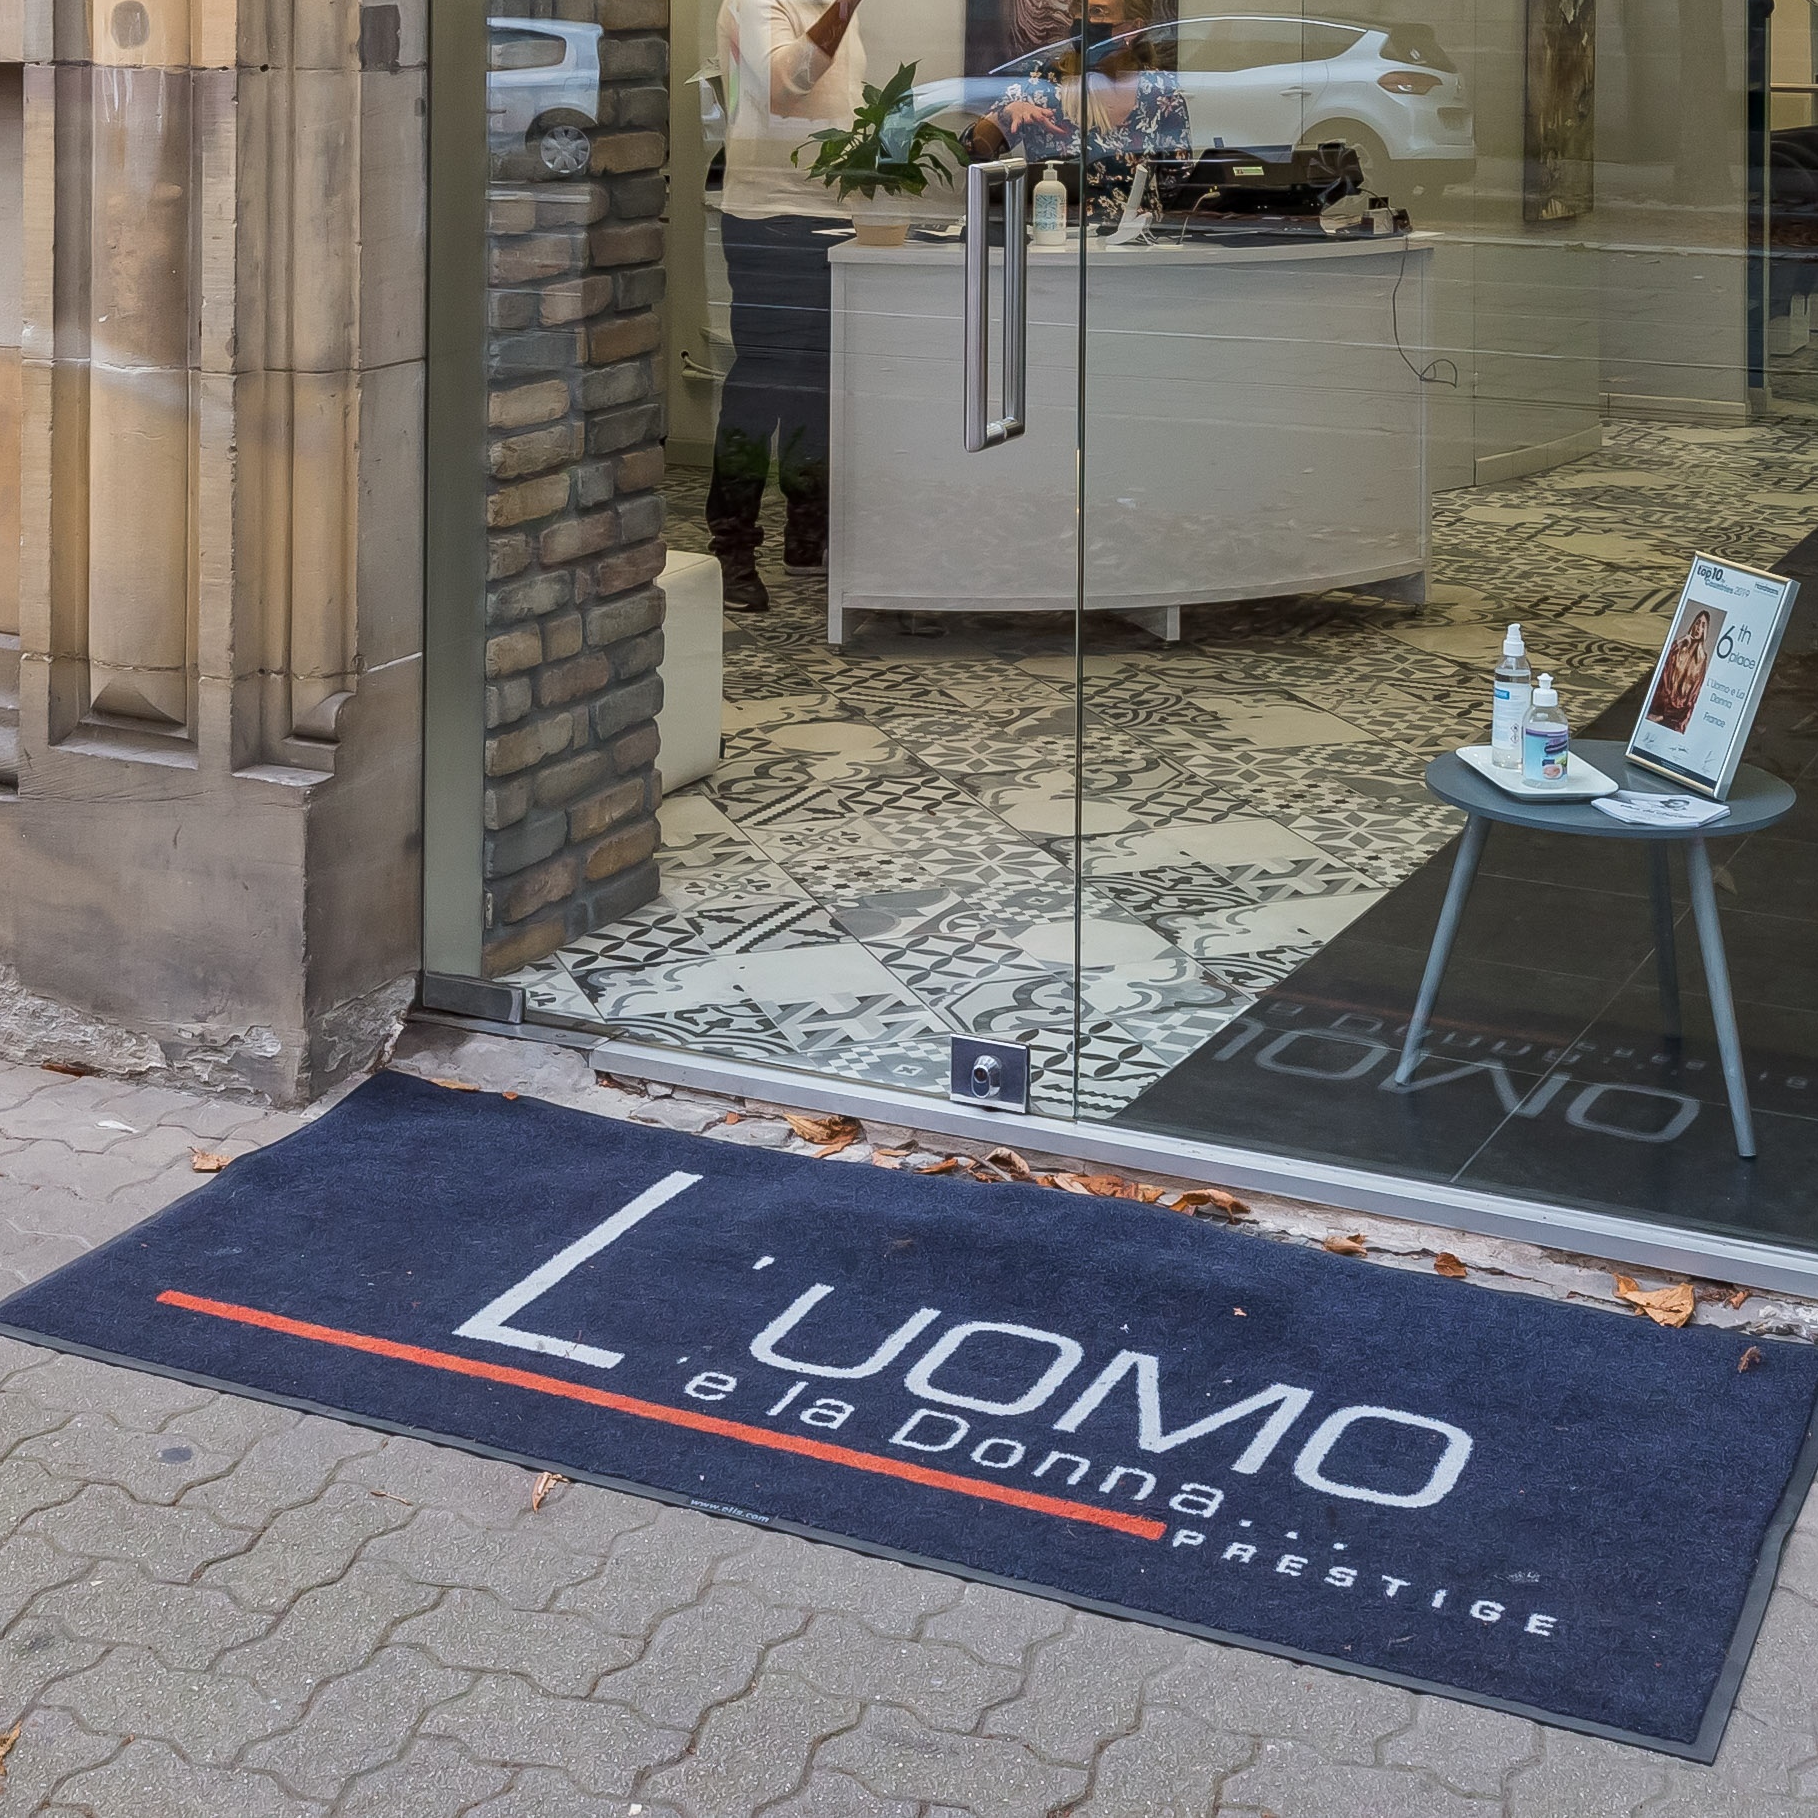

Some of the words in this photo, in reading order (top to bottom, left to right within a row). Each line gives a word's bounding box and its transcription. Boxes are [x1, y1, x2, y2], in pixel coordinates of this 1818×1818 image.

[1716, 625, 1735, 659] 6
[1737, 623, 1752, 645] th
[1728, 652, 1756, 670] place
[1710, 693, 1733, 710] Donna
[1703, 712, 1726, 729] France
[452, 1169, 1474, 1509] L'UOMO
[683, 1371, 738, 1401] e
[767, 1380, 856, 1431] la
[1171, 1529, 1558, 1637] PRESTIGE
